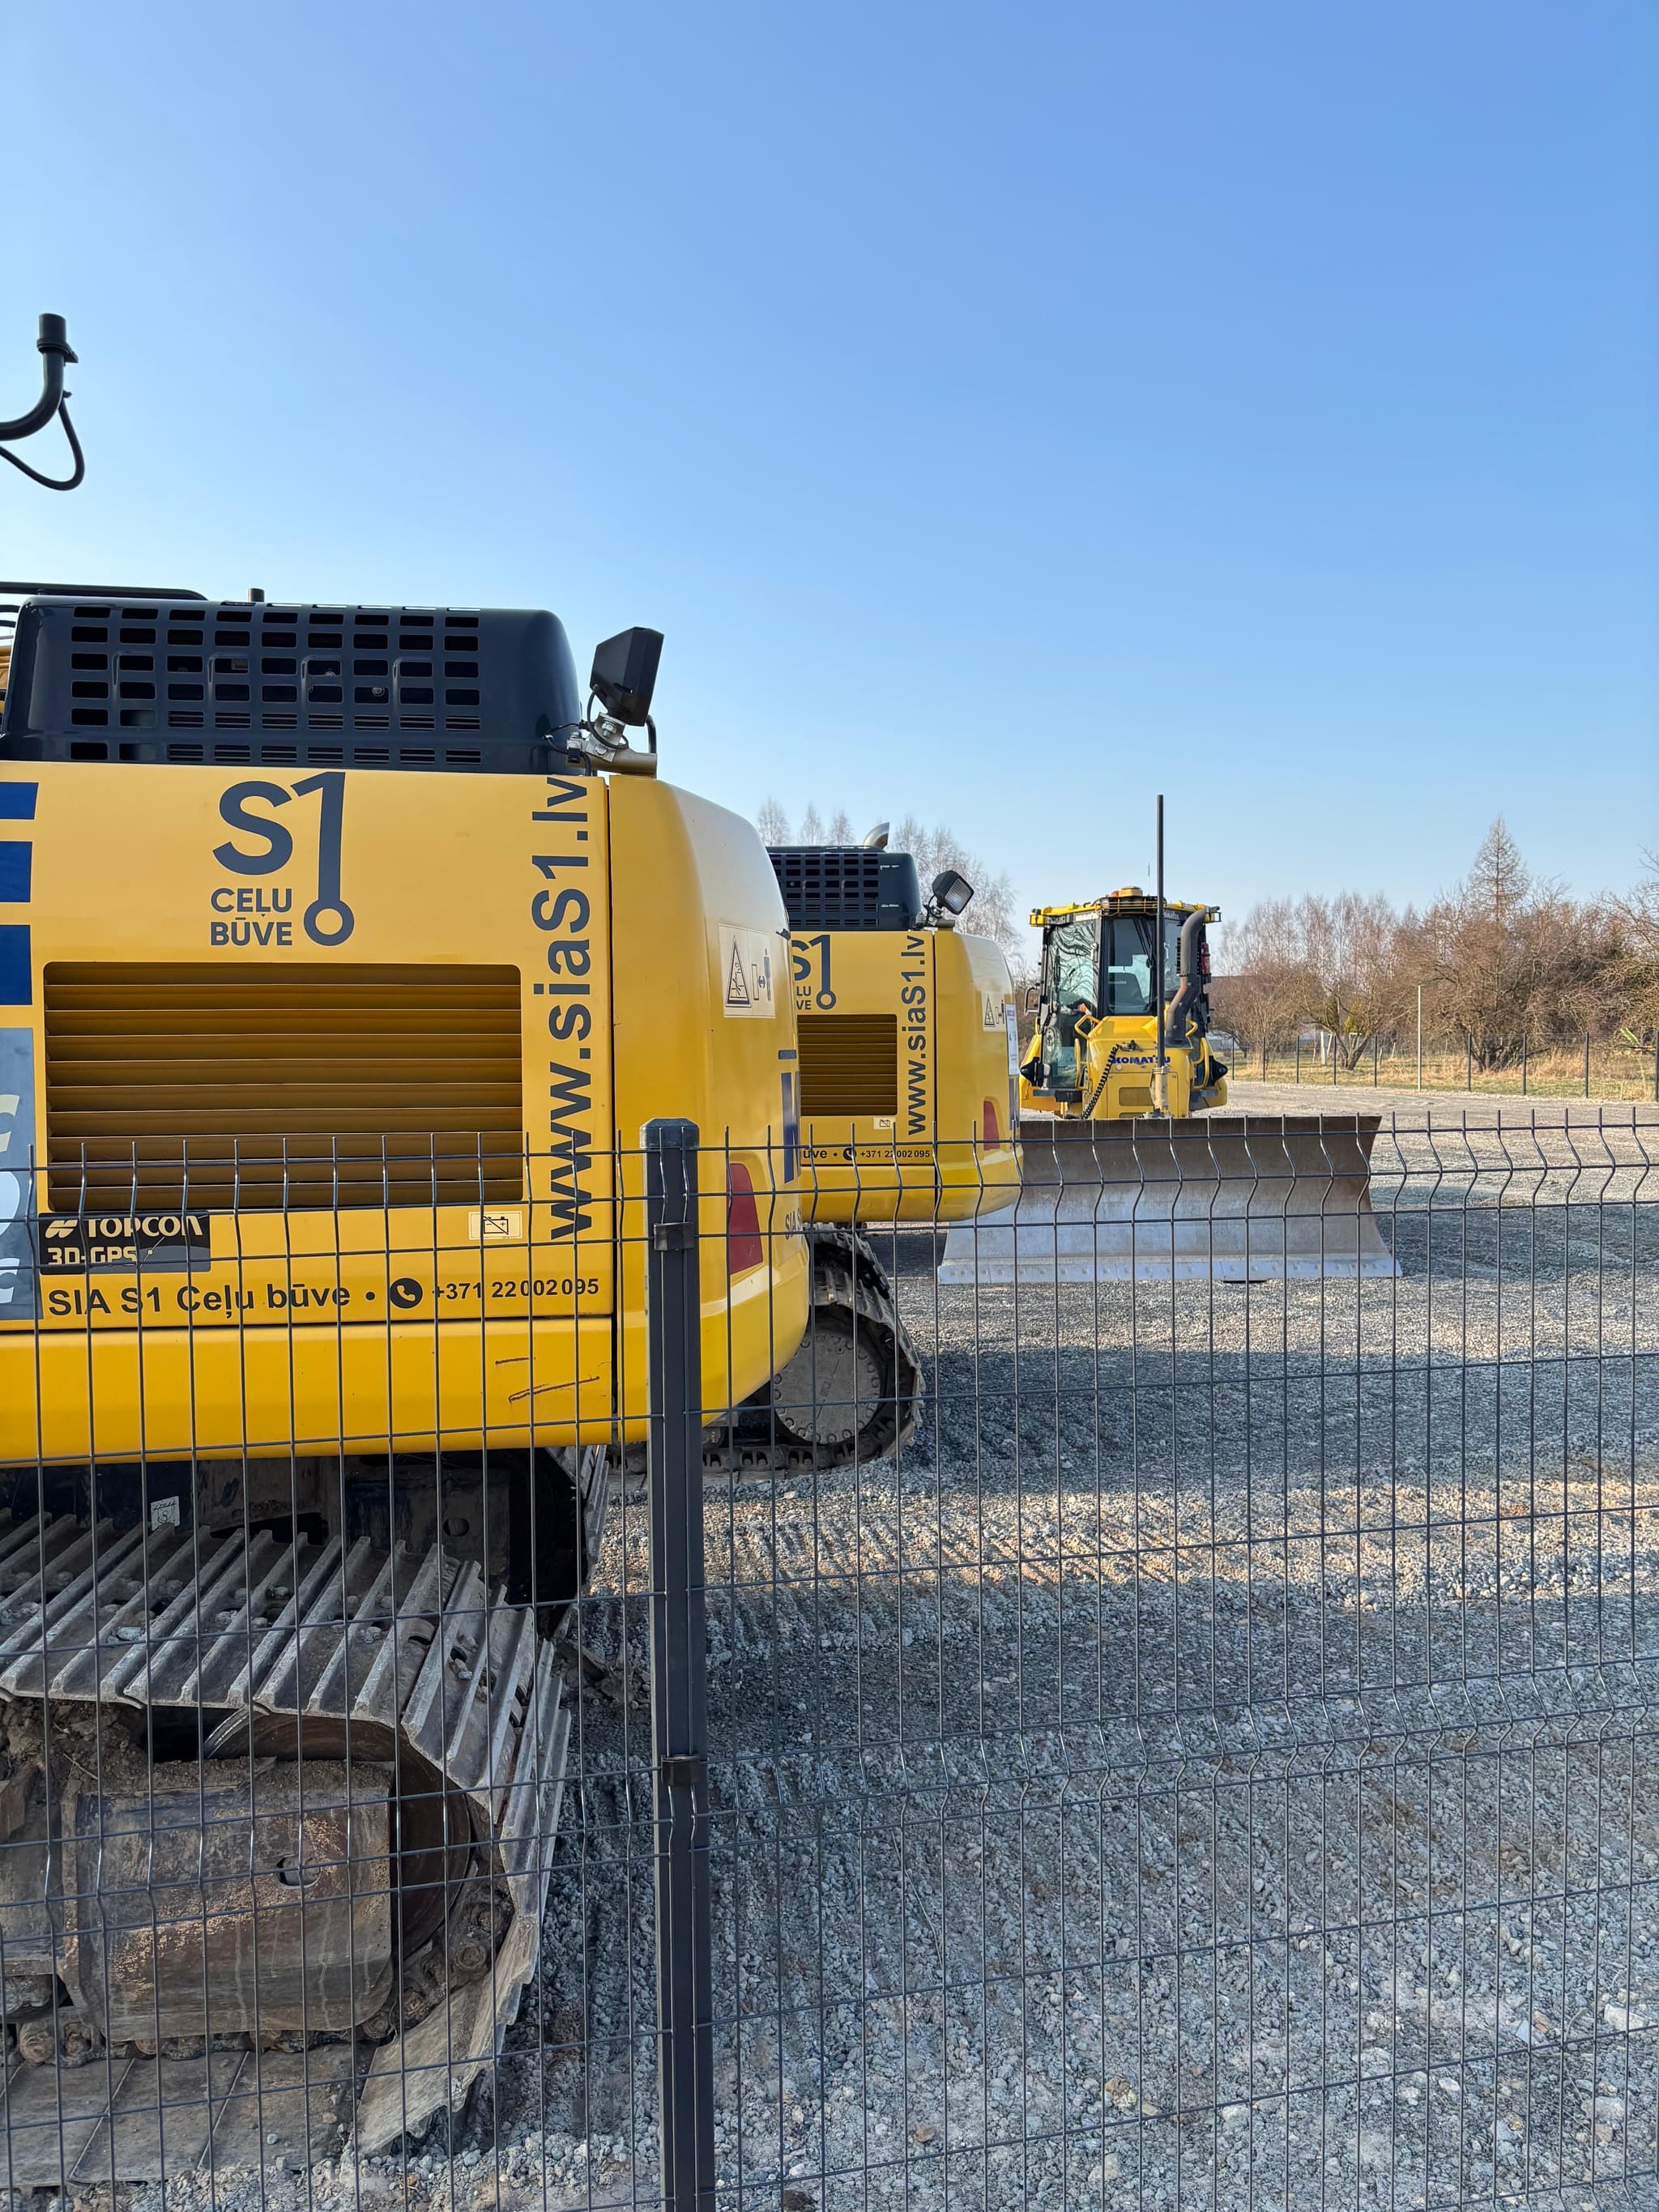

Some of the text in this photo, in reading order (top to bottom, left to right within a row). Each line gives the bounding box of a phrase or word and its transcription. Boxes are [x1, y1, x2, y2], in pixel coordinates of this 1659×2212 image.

[212, 771, 355, 946] S1
[211, 917, 292, 946] BŪVE
[531, 776, 592, 1240] www.siaS1.lv
[901, 935, 927, 1136] www.siaS1.lv
[86, 1216, 203, 1238] TOPCON
[49, 1289, 111, 1316] SIA
[121, 1286, 161, 1313] S1
[177, 1285, 254, 1319] Ceļu
[267, 1283, 351, 1309] būve
[433, 1282, 481, 1300] +371
